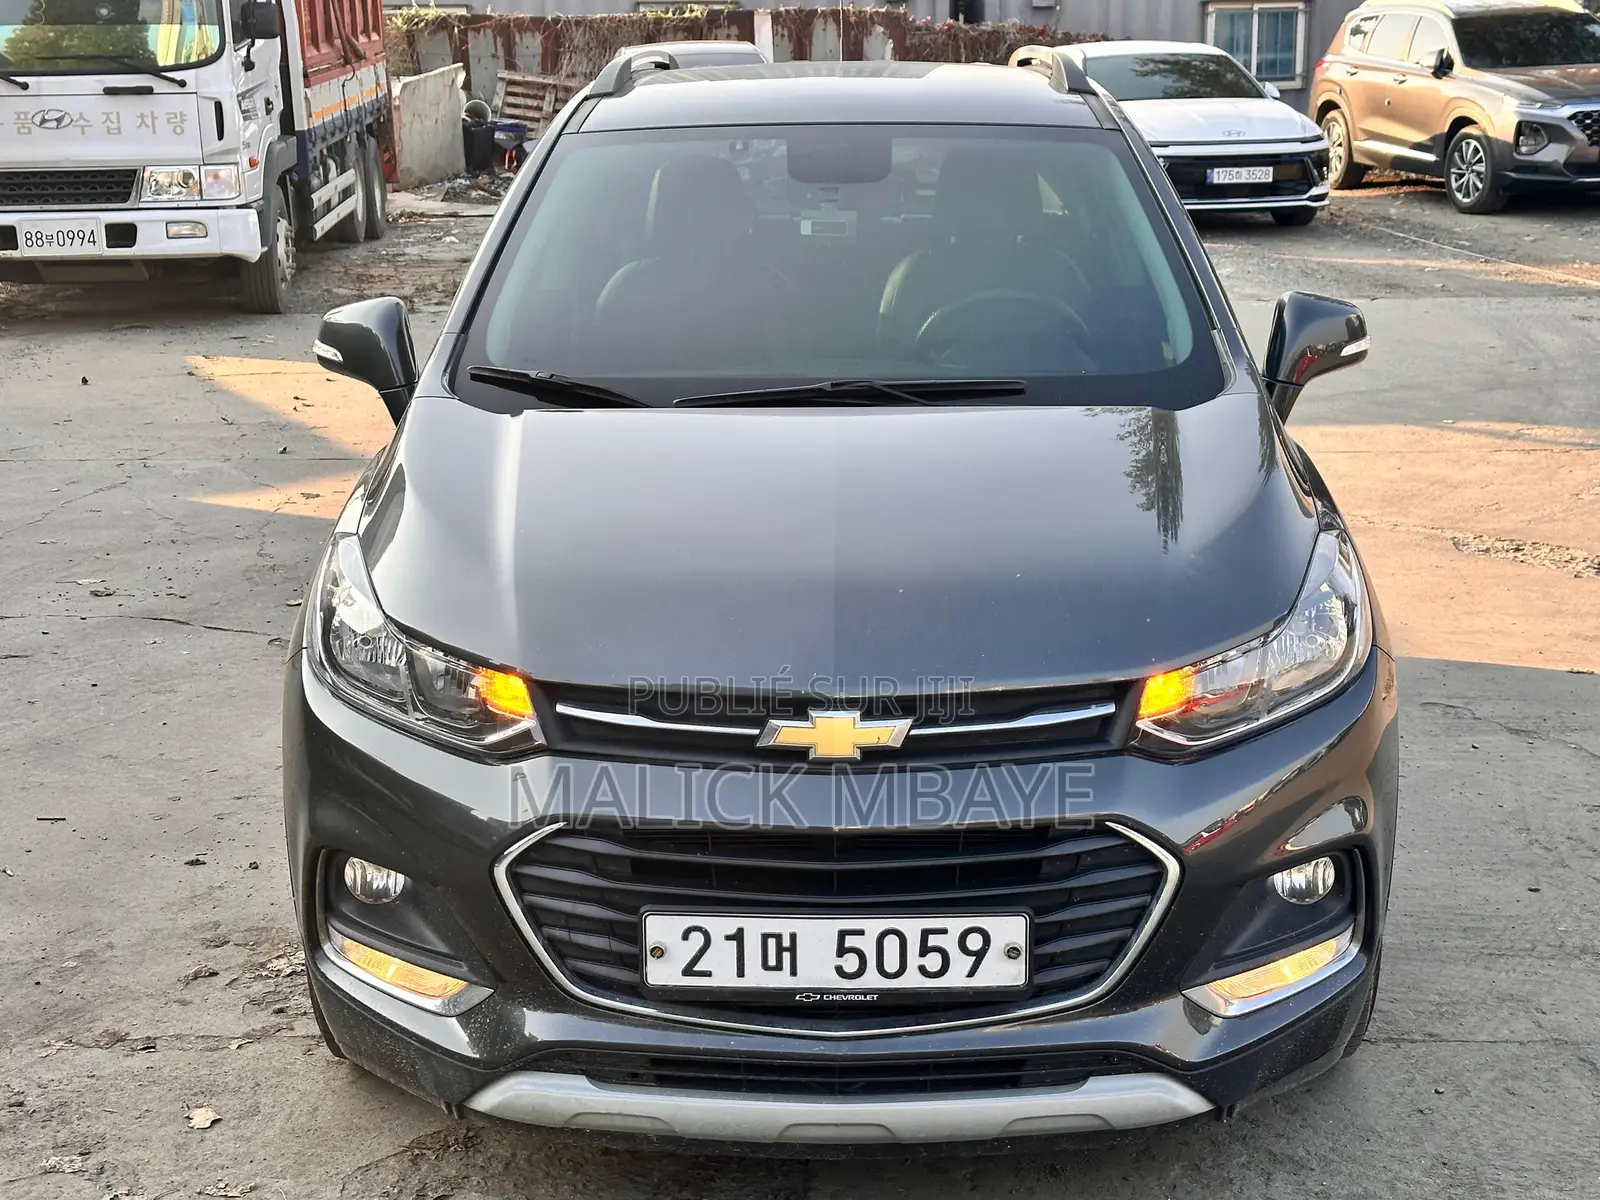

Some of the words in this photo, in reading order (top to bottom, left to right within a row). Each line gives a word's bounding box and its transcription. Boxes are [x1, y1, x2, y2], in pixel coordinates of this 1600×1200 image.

[0, 111, 33, 135] 품
[136, 110, 188, 135] 차량
[1245, 168, 1271, 181] 3528
[24, 229, 97, 248] 88부0994
[681, 925, 798, 978] 21머
[833, 926, 992, 980] 5059
